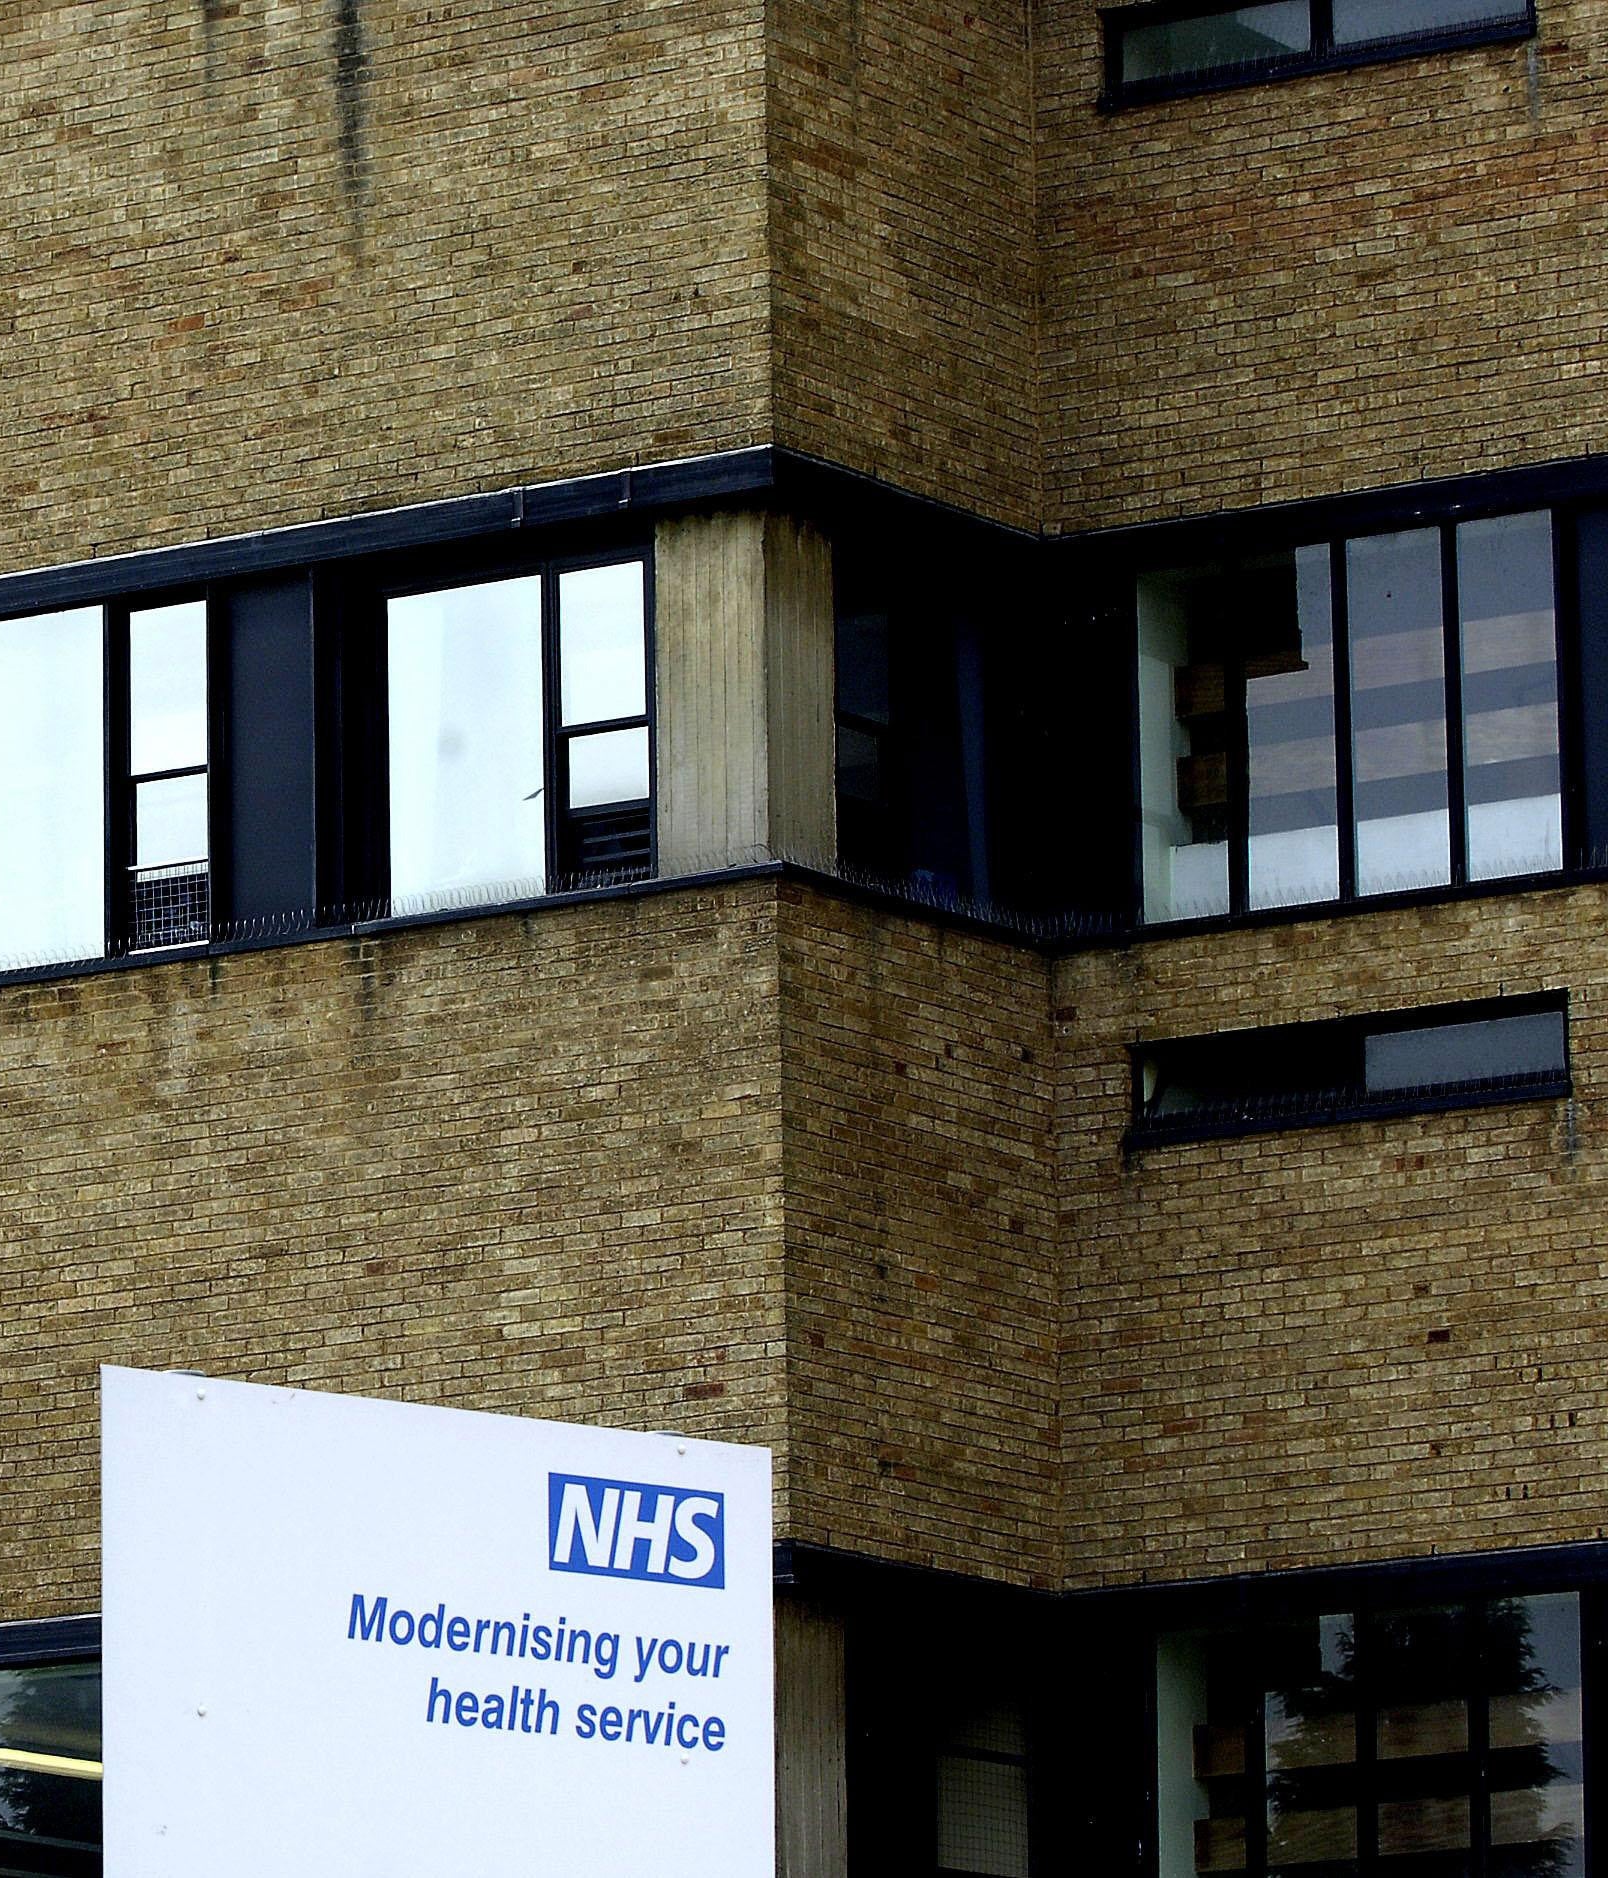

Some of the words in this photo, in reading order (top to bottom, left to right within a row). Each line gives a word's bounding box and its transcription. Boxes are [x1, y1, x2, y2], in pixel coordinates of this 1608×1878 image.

[552, 1482, 719, 1580] NHS
[347, 1593, 620, 1679] Modernising
[633, 1636, 730, 1682] your
[426, 1677, 560, 1735] health
[575, 1702, 726, 1752] service
